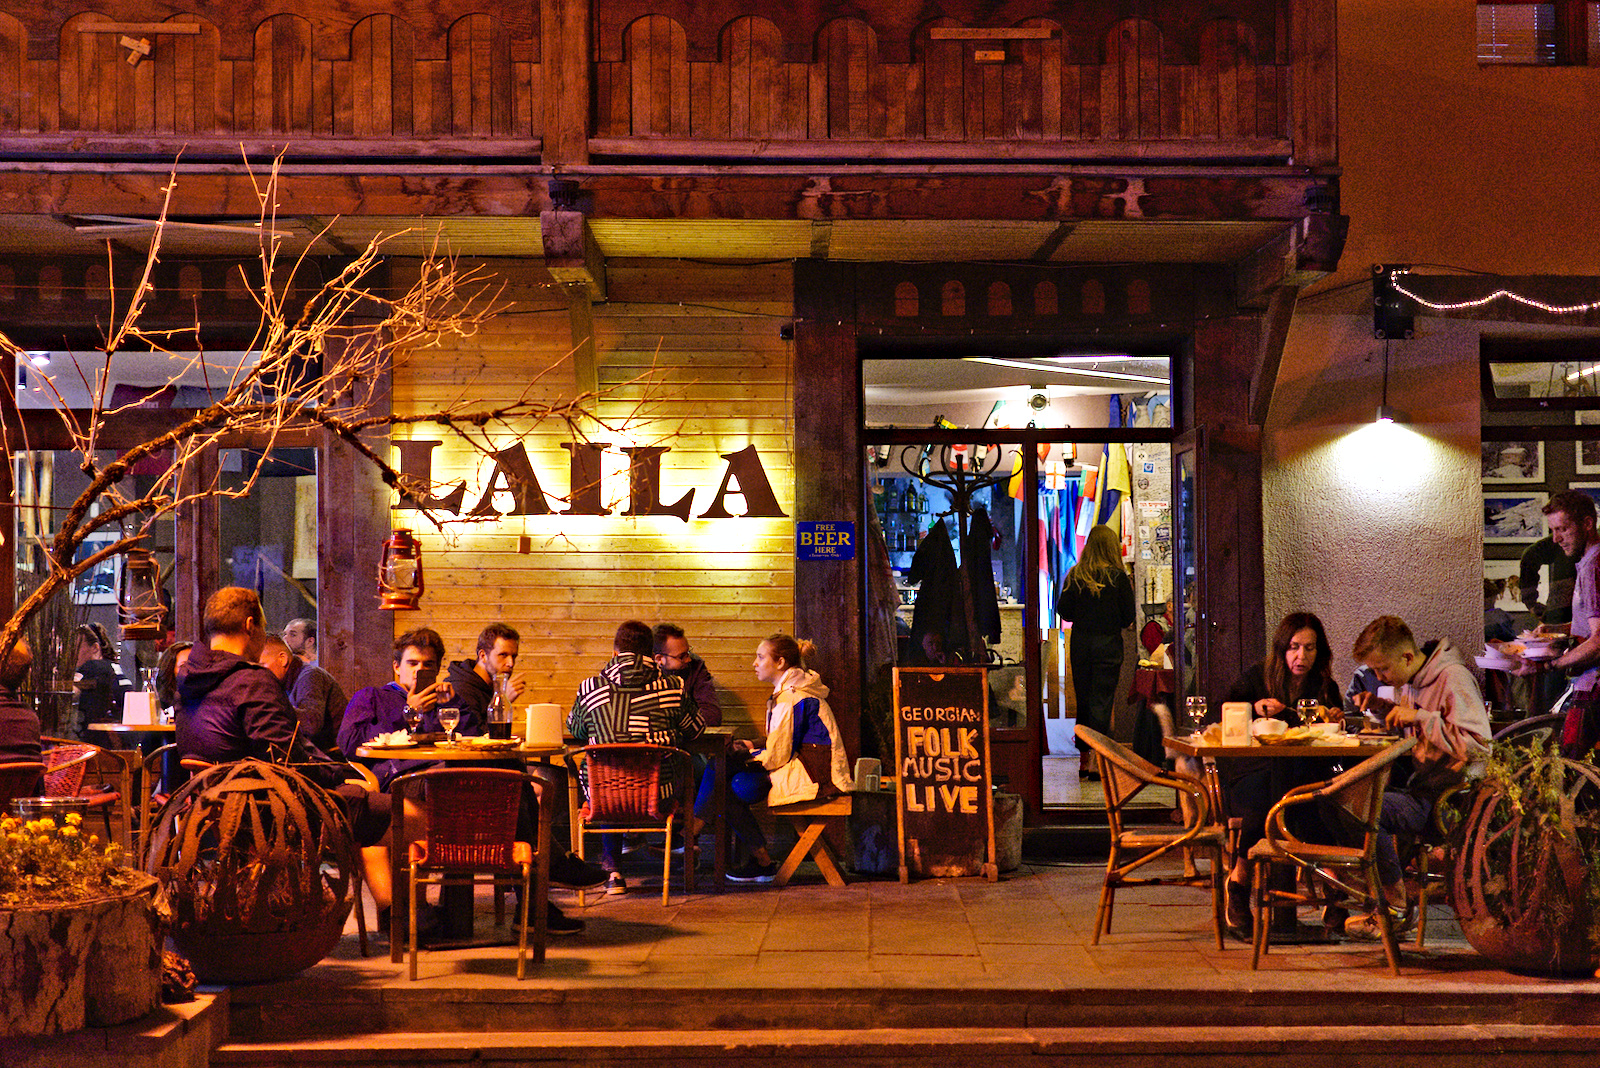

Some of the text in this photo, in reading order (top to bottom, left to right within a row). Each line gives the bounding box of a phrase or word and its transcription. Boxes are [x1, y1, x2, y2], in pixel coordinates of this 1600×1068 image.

[390, 440, 790, 523] LAILA
[800, 532, 851, 546] BEER
[901, 706, 981, 722] GEORGIAN
[907, 726, 979, 759] FOLK
[902, 756, 982, 782] MUSIC
[905, 783, 978, 814] LIVE
